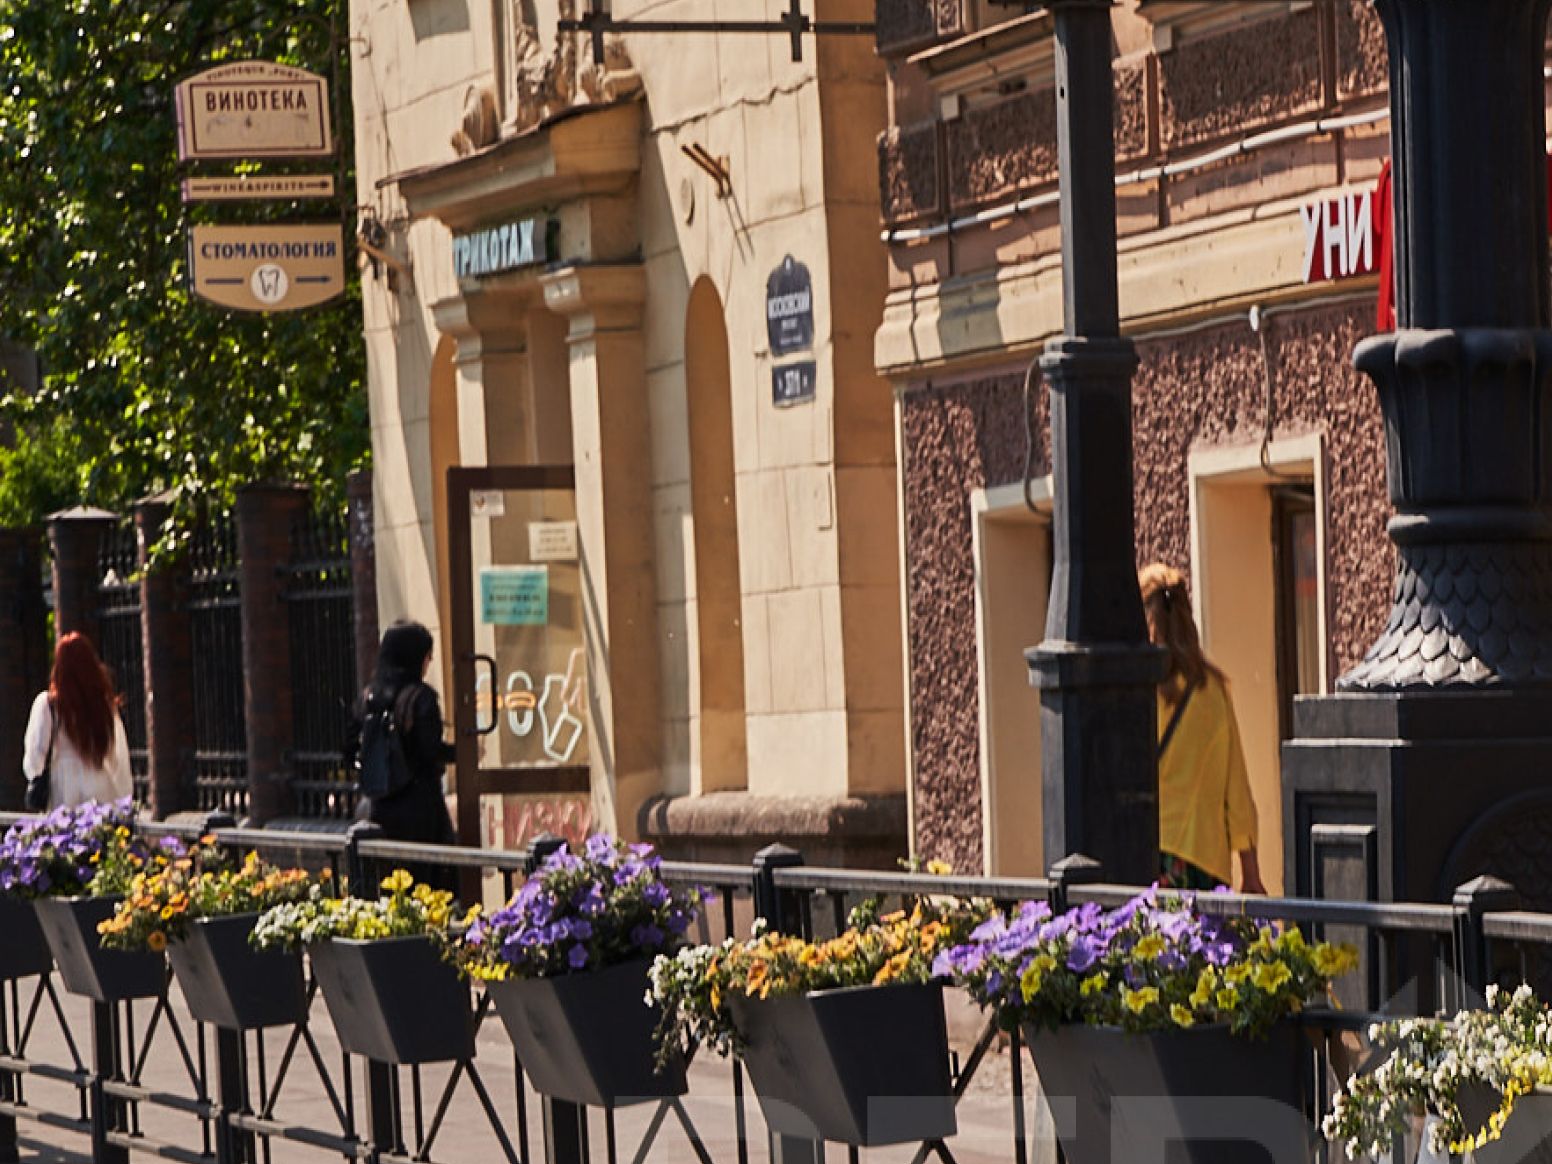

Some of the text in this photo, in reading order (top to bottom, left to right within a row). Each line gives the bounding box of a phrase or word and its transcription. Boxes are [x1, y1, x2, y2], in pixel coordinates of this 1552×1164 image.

[205, 89, 308, 112] ВИНОТЕКА
[201, 240, 337, 260] СТОМАТОЛОГИЯ
[453, 218, 535, 277] ТРИКОТАЖ
